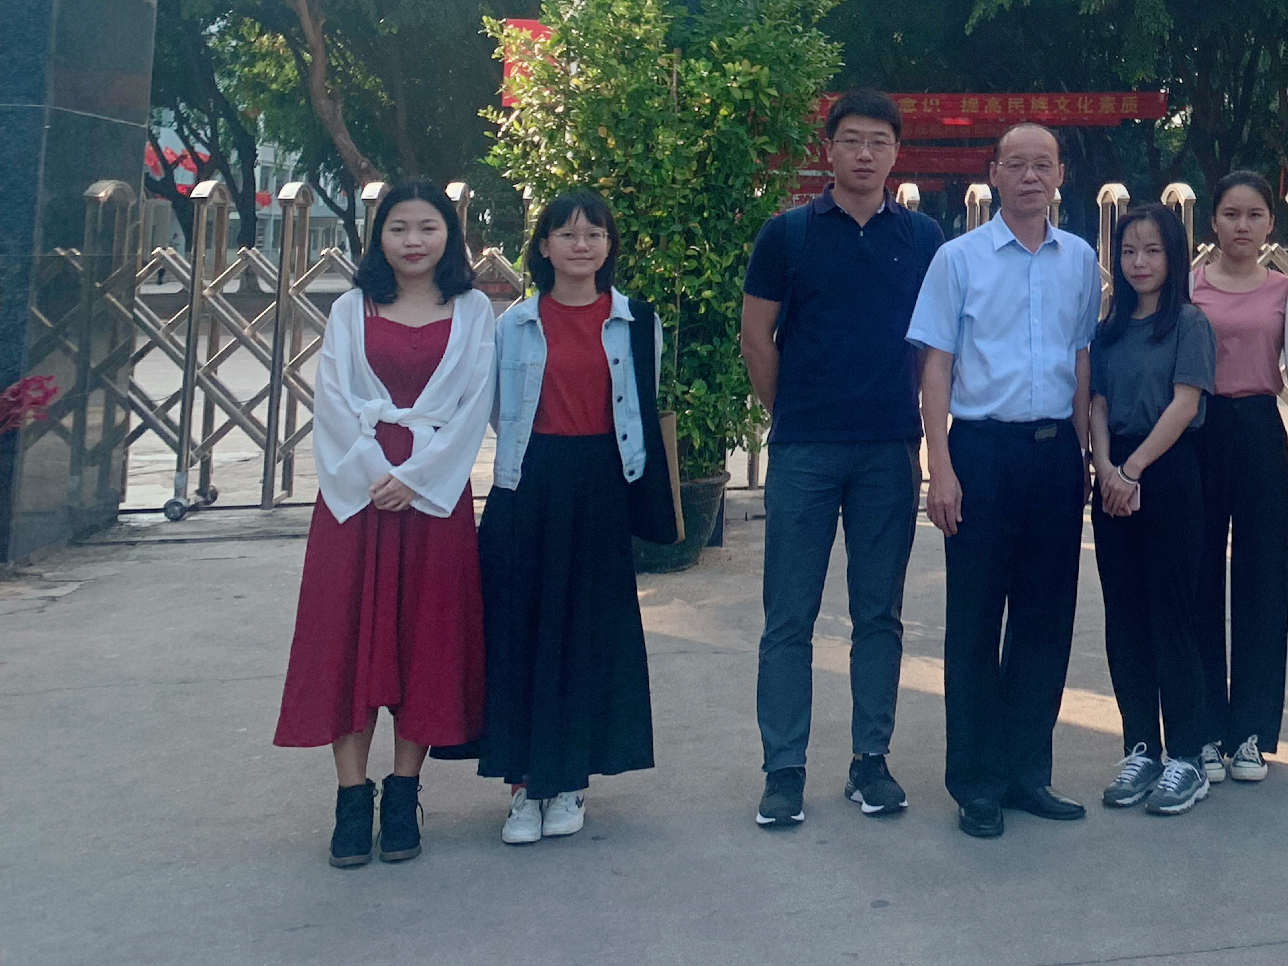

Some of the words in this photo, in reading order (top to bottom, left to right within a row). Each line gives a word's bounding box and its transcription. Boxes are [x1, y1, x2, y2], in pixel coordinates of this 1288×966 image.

[960, 96, 1139, 114] 提高民族文化素质
